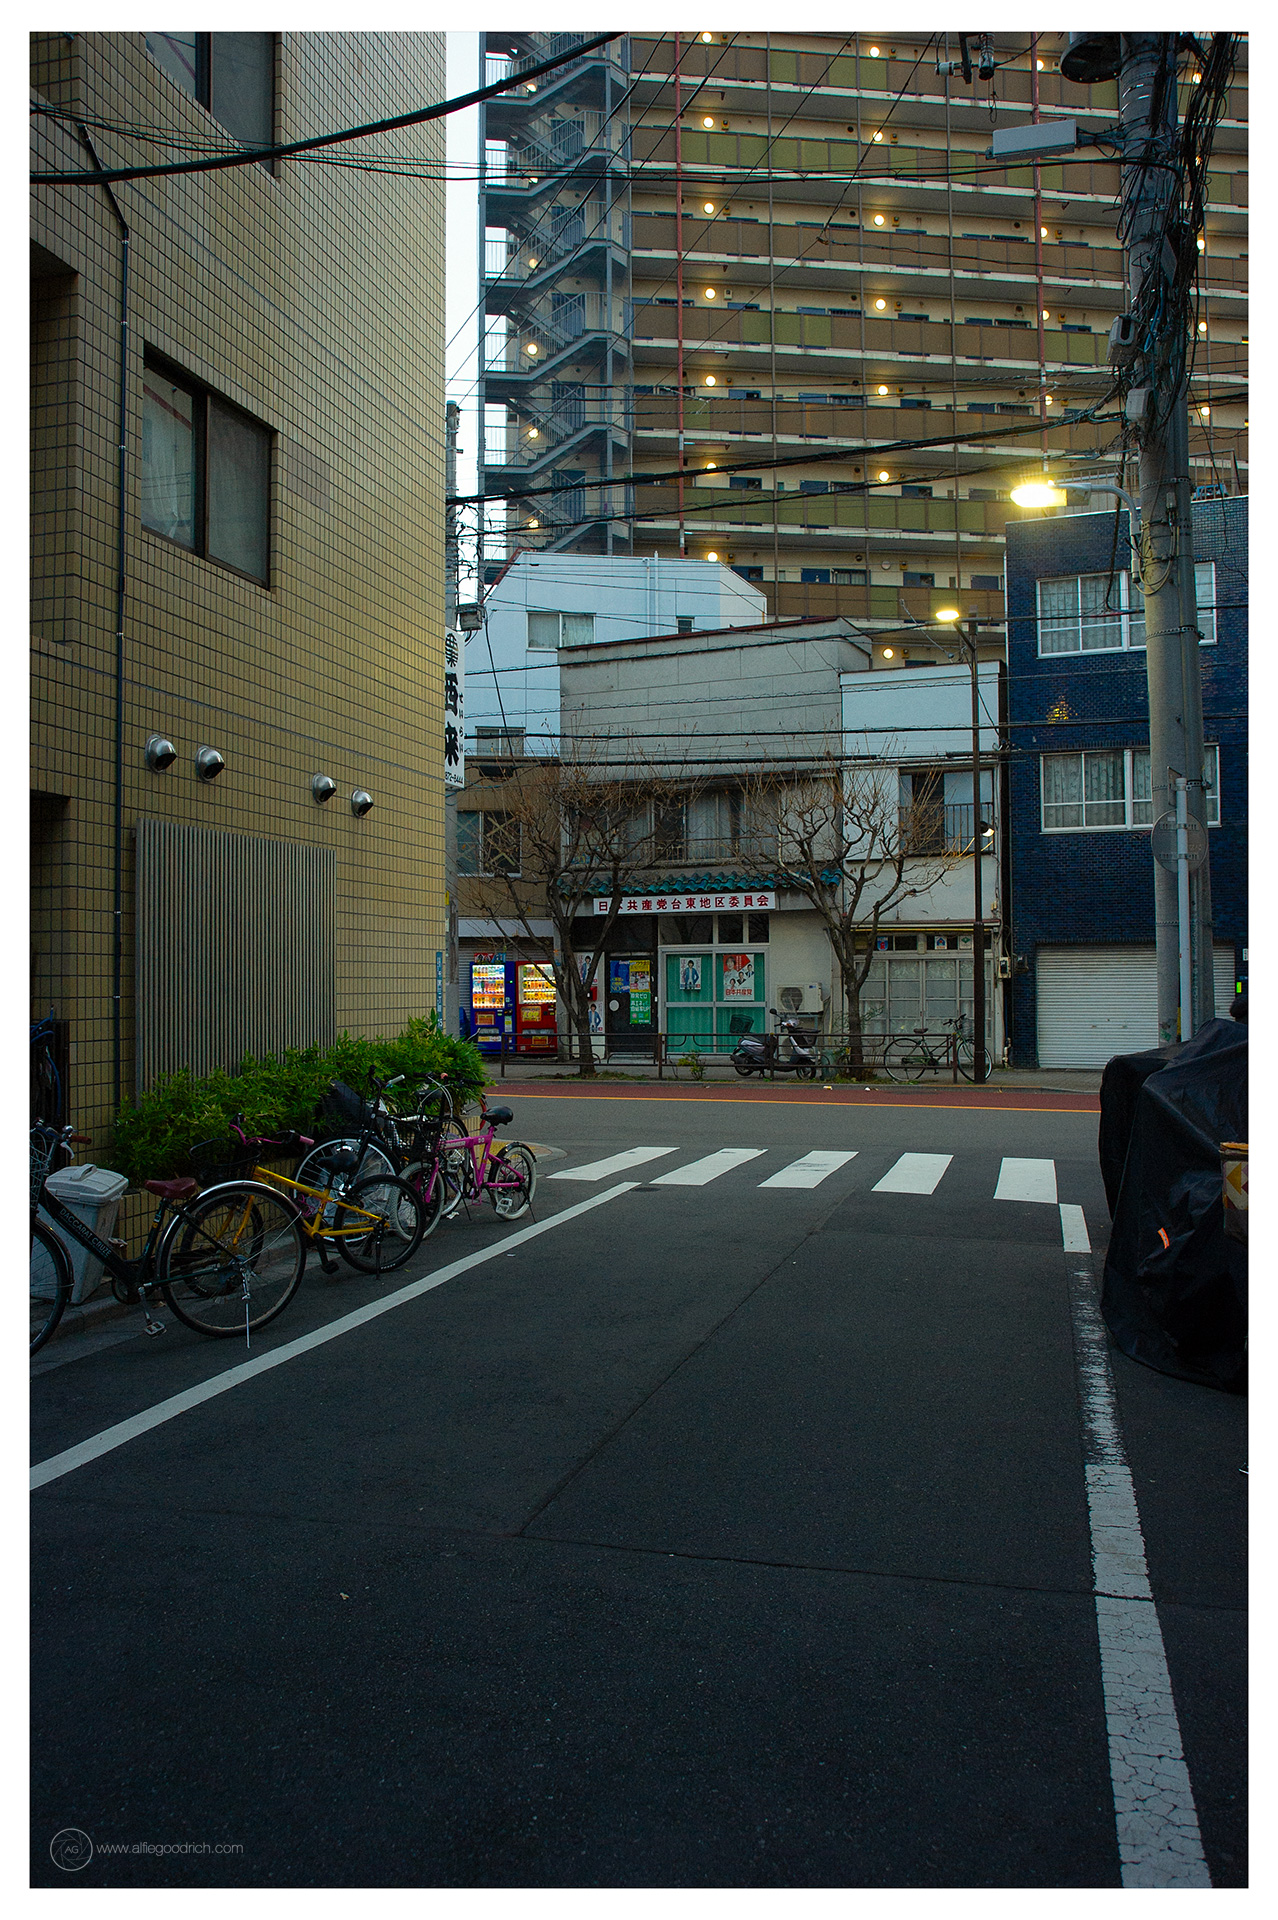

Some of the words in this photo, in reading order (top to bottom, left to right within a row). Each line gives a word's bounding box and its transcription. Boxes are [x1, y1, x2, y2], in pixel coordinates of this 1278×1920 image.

[598, 894, 770, 912] 日共産党台東地区委員会
